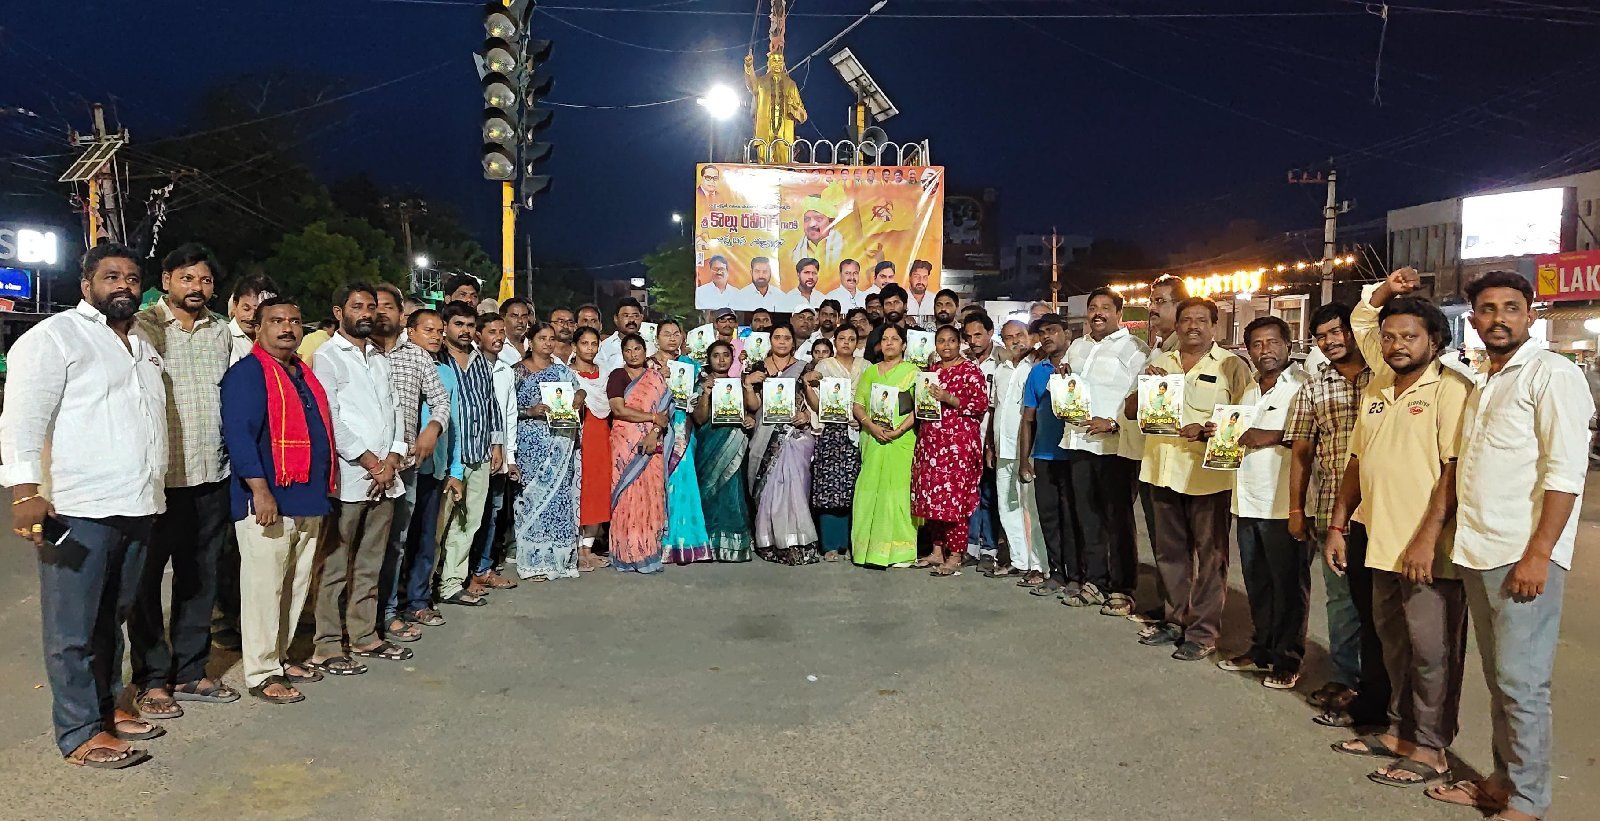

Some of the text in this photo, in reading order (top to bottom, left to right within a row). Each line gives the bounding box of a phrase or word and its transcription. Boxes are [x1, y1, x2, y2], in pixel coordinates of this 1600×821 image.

[710, 212, 738, 233] కొల్లు
[1559, 264, 1600, 293] LAK
[1368, 401, 1385, 415] 23
